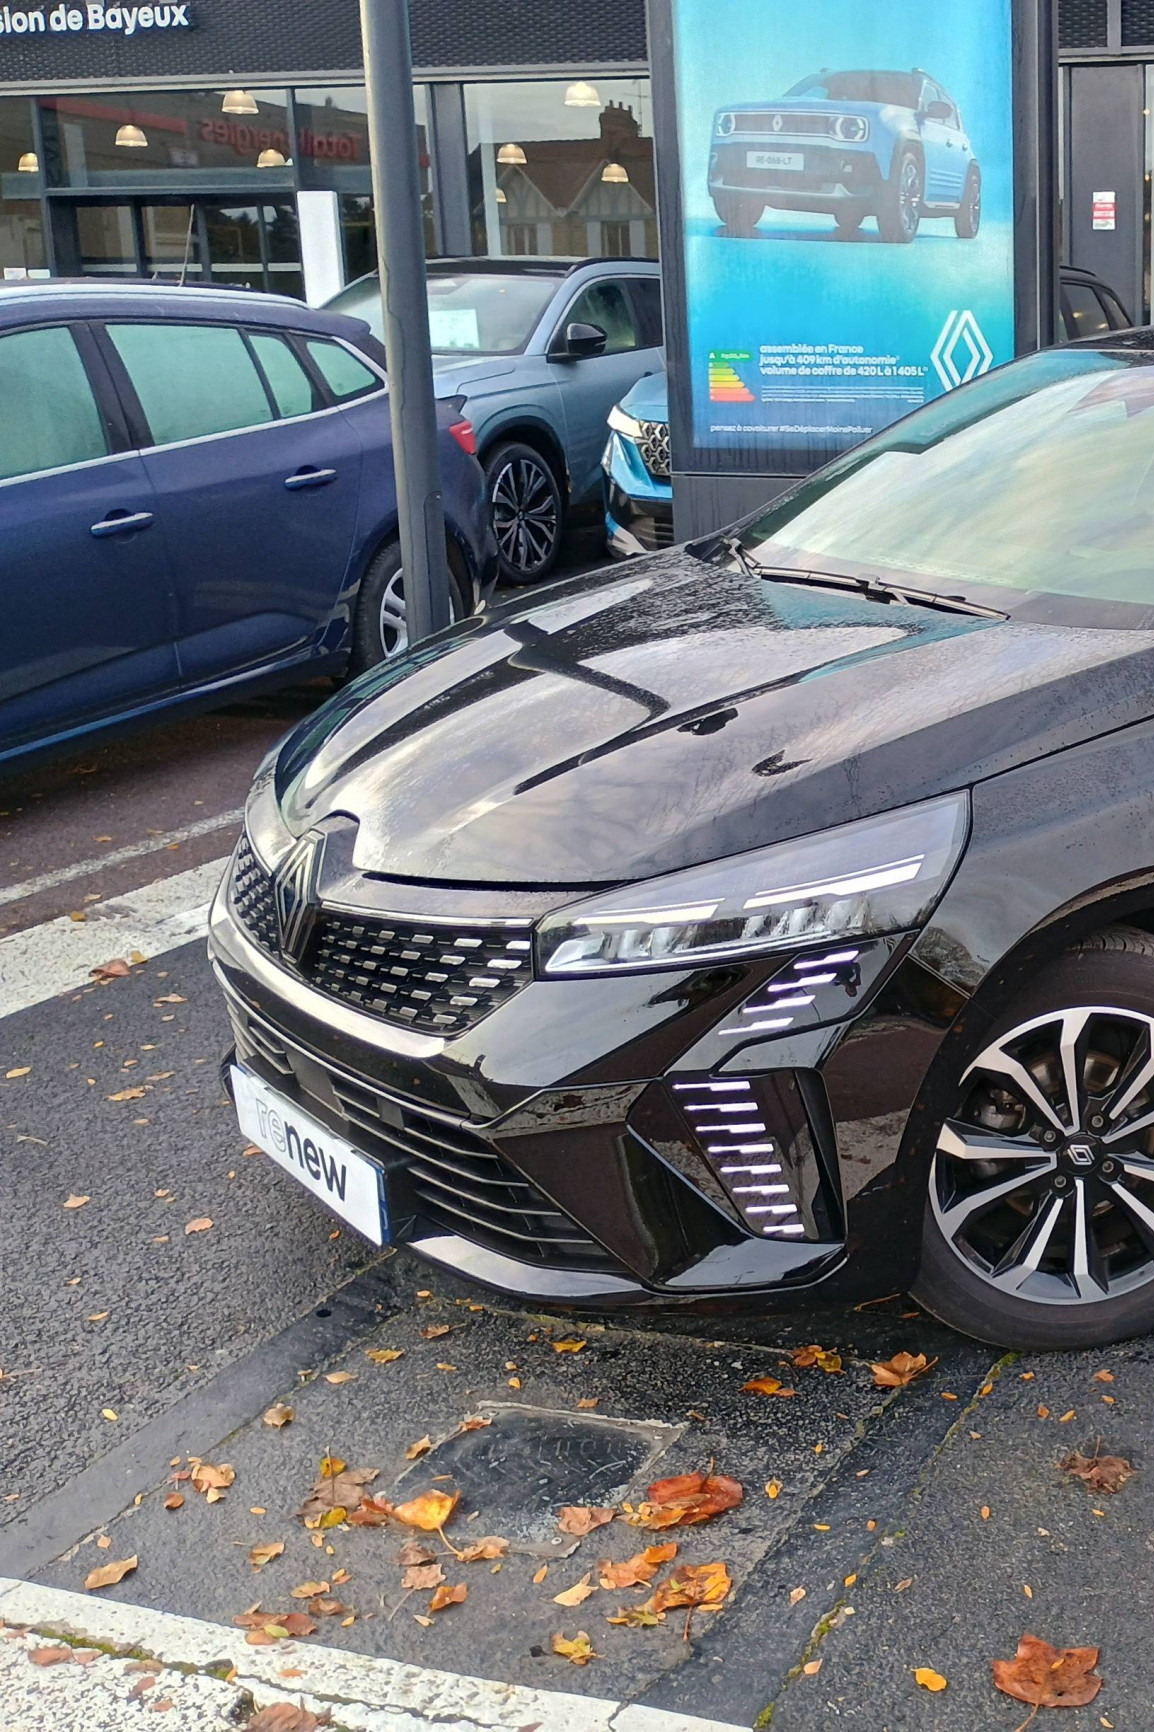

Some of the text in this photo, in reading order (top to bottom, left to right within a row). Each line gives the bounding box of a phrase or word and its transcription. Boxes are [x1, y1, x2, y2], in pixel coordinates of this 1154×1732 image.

[50, 4, 83, 32] de
[87, 4, 189, 35] Bayeux
[760, 343, 864, 353] assemblée en France
[797, 355, 815, 364] 409
[816, 355, 832, 364] km
[760, 365, 797, 375] volume
[798, 365, 811, 375] de
[812, 365, 842, 375] coffre
[843, 365, 856, 375] de
[255, 1098, 347, 1202] renew
